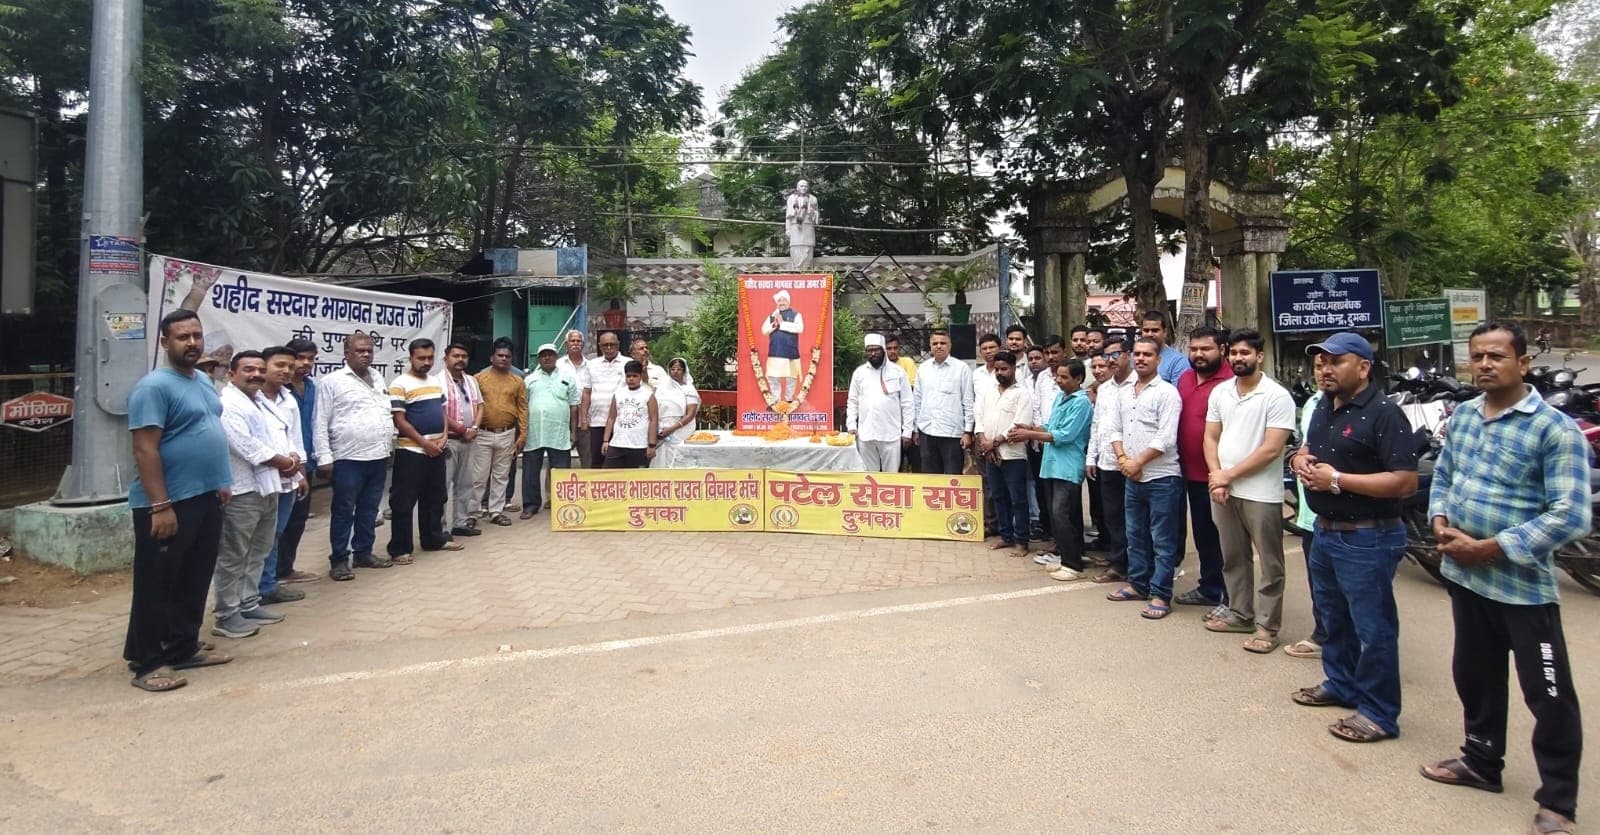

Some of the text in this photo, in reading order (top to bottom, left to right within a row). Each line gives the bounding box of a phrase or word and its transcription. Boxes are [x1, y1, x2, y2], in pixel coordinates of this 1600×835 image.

[212, 275, 425, 328] शहीद सरदार भागवत राउत जी
[1279, 313, 1302, 326] जिला
[1303, 313, 1326, 326] उद्योग
[1347, 313, 1370, 327] दुमका
[391, 337, 407, 352] पर
[393, 360, 405, 375] में
[9, 400, 69, 418] मोंगिया
[556, 472, 760, 501] शहीद सरदार भागवत राउत विचार मंच
[769, 473, 982, 510] पटेल सेवा संघ
[628, 506, 688, 527] दुमका
[842, 510, 904, 533] दुमका
